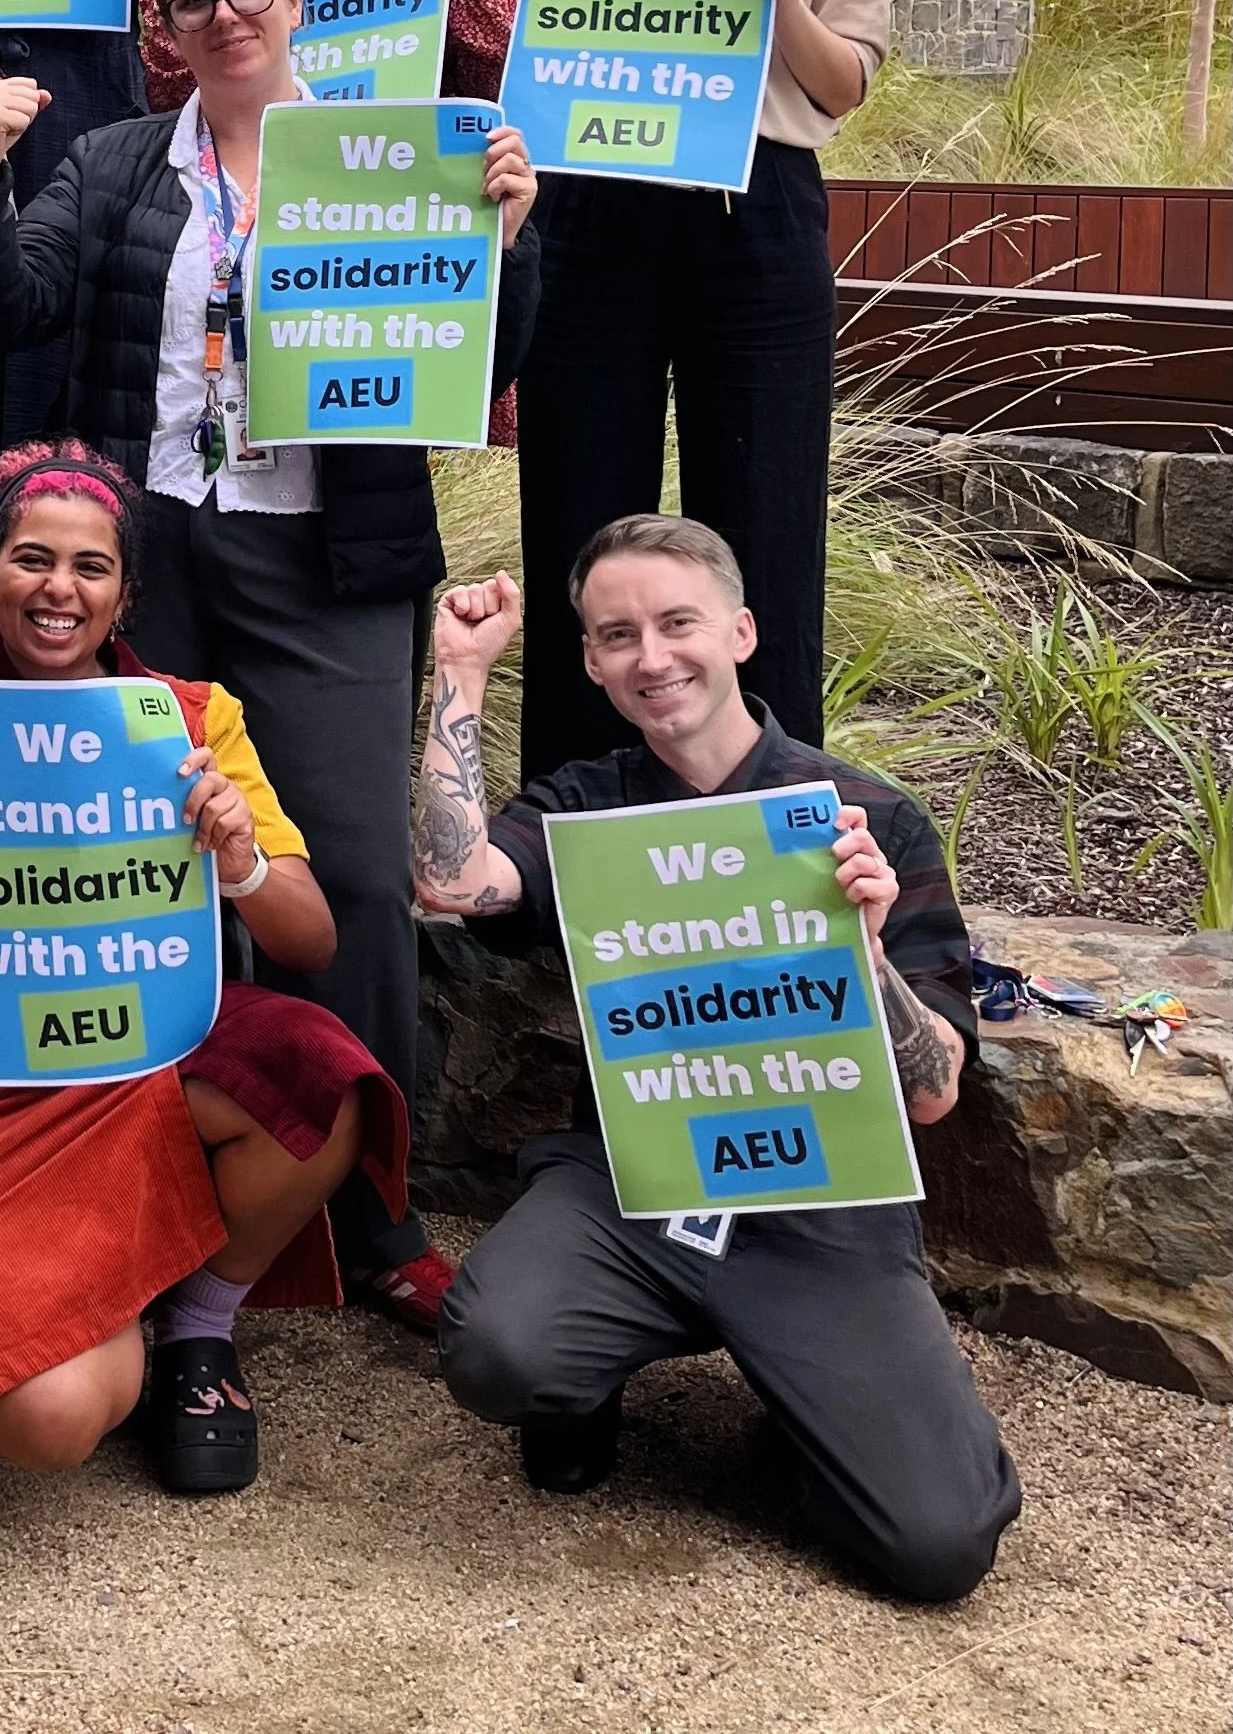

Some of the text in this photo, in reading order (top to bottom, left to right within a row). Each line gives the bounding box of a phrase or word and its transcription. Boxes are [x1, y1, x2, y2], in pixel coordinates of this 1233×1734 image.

[538, 0, 751, 46] solidarity
[291, 33, 420, 74] ith the
[533, 52, 733, 100] with the
[456, 117, 491, 133] IEU
[578, 118, 665, 147] AEU
[339, 136, 415, 169] We
[277, 192, 471, 231] stand in
[271, 253, 475, 292] solidarity
[270, 310, 464, 349] with the
[319, 377, 400, 409] AEU
[140, 699, 169, 715] IEU
[14, 724, 101, 762] We
[123, 788, 175, 831] in
[787, 805, 830, 829] IEU
[646, 842, 746, 885] We
[594, 900, 828, 961] stand in
[98, 933, 188, 972] the
[608, 973, 847, 1035] solidarity
[39, 1005, 129, 1048] AEU
[622, 1051, 861, 1103] with the
[714, 1128, 806, 1173] AEU
